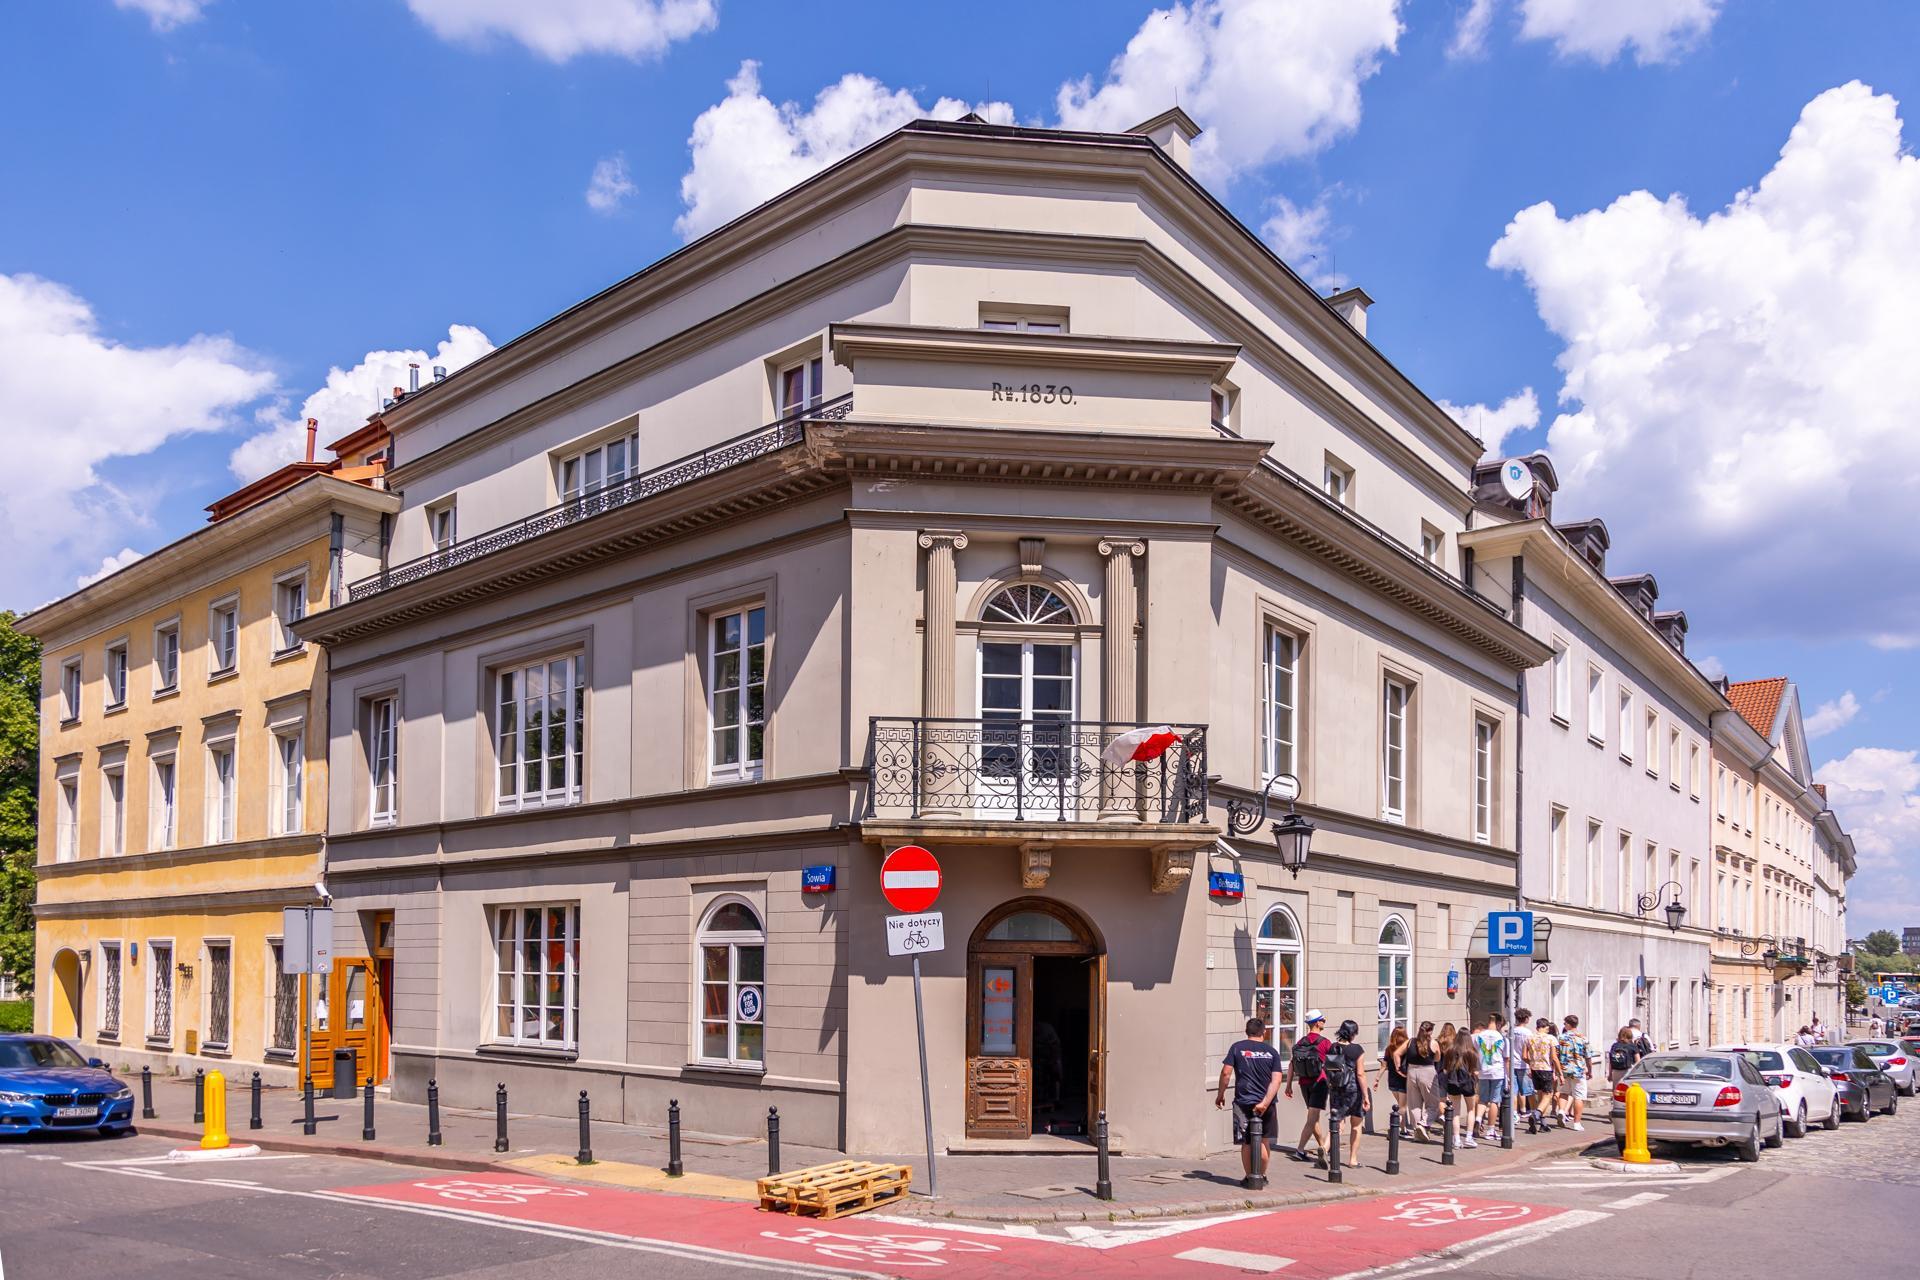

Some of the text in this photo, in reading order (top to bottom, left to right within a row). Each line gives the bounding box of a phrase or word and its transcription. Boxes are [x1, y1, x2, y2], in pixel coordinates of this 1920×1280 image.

[807, 873, 826, 884] Sowia
[1218, 878, 1240, 890] Bednarska
[888, 918, 941, 930] Nie dotyczy
[1498, 916, 1524, 949] P
[1887, 991, 1896, 1000] P
